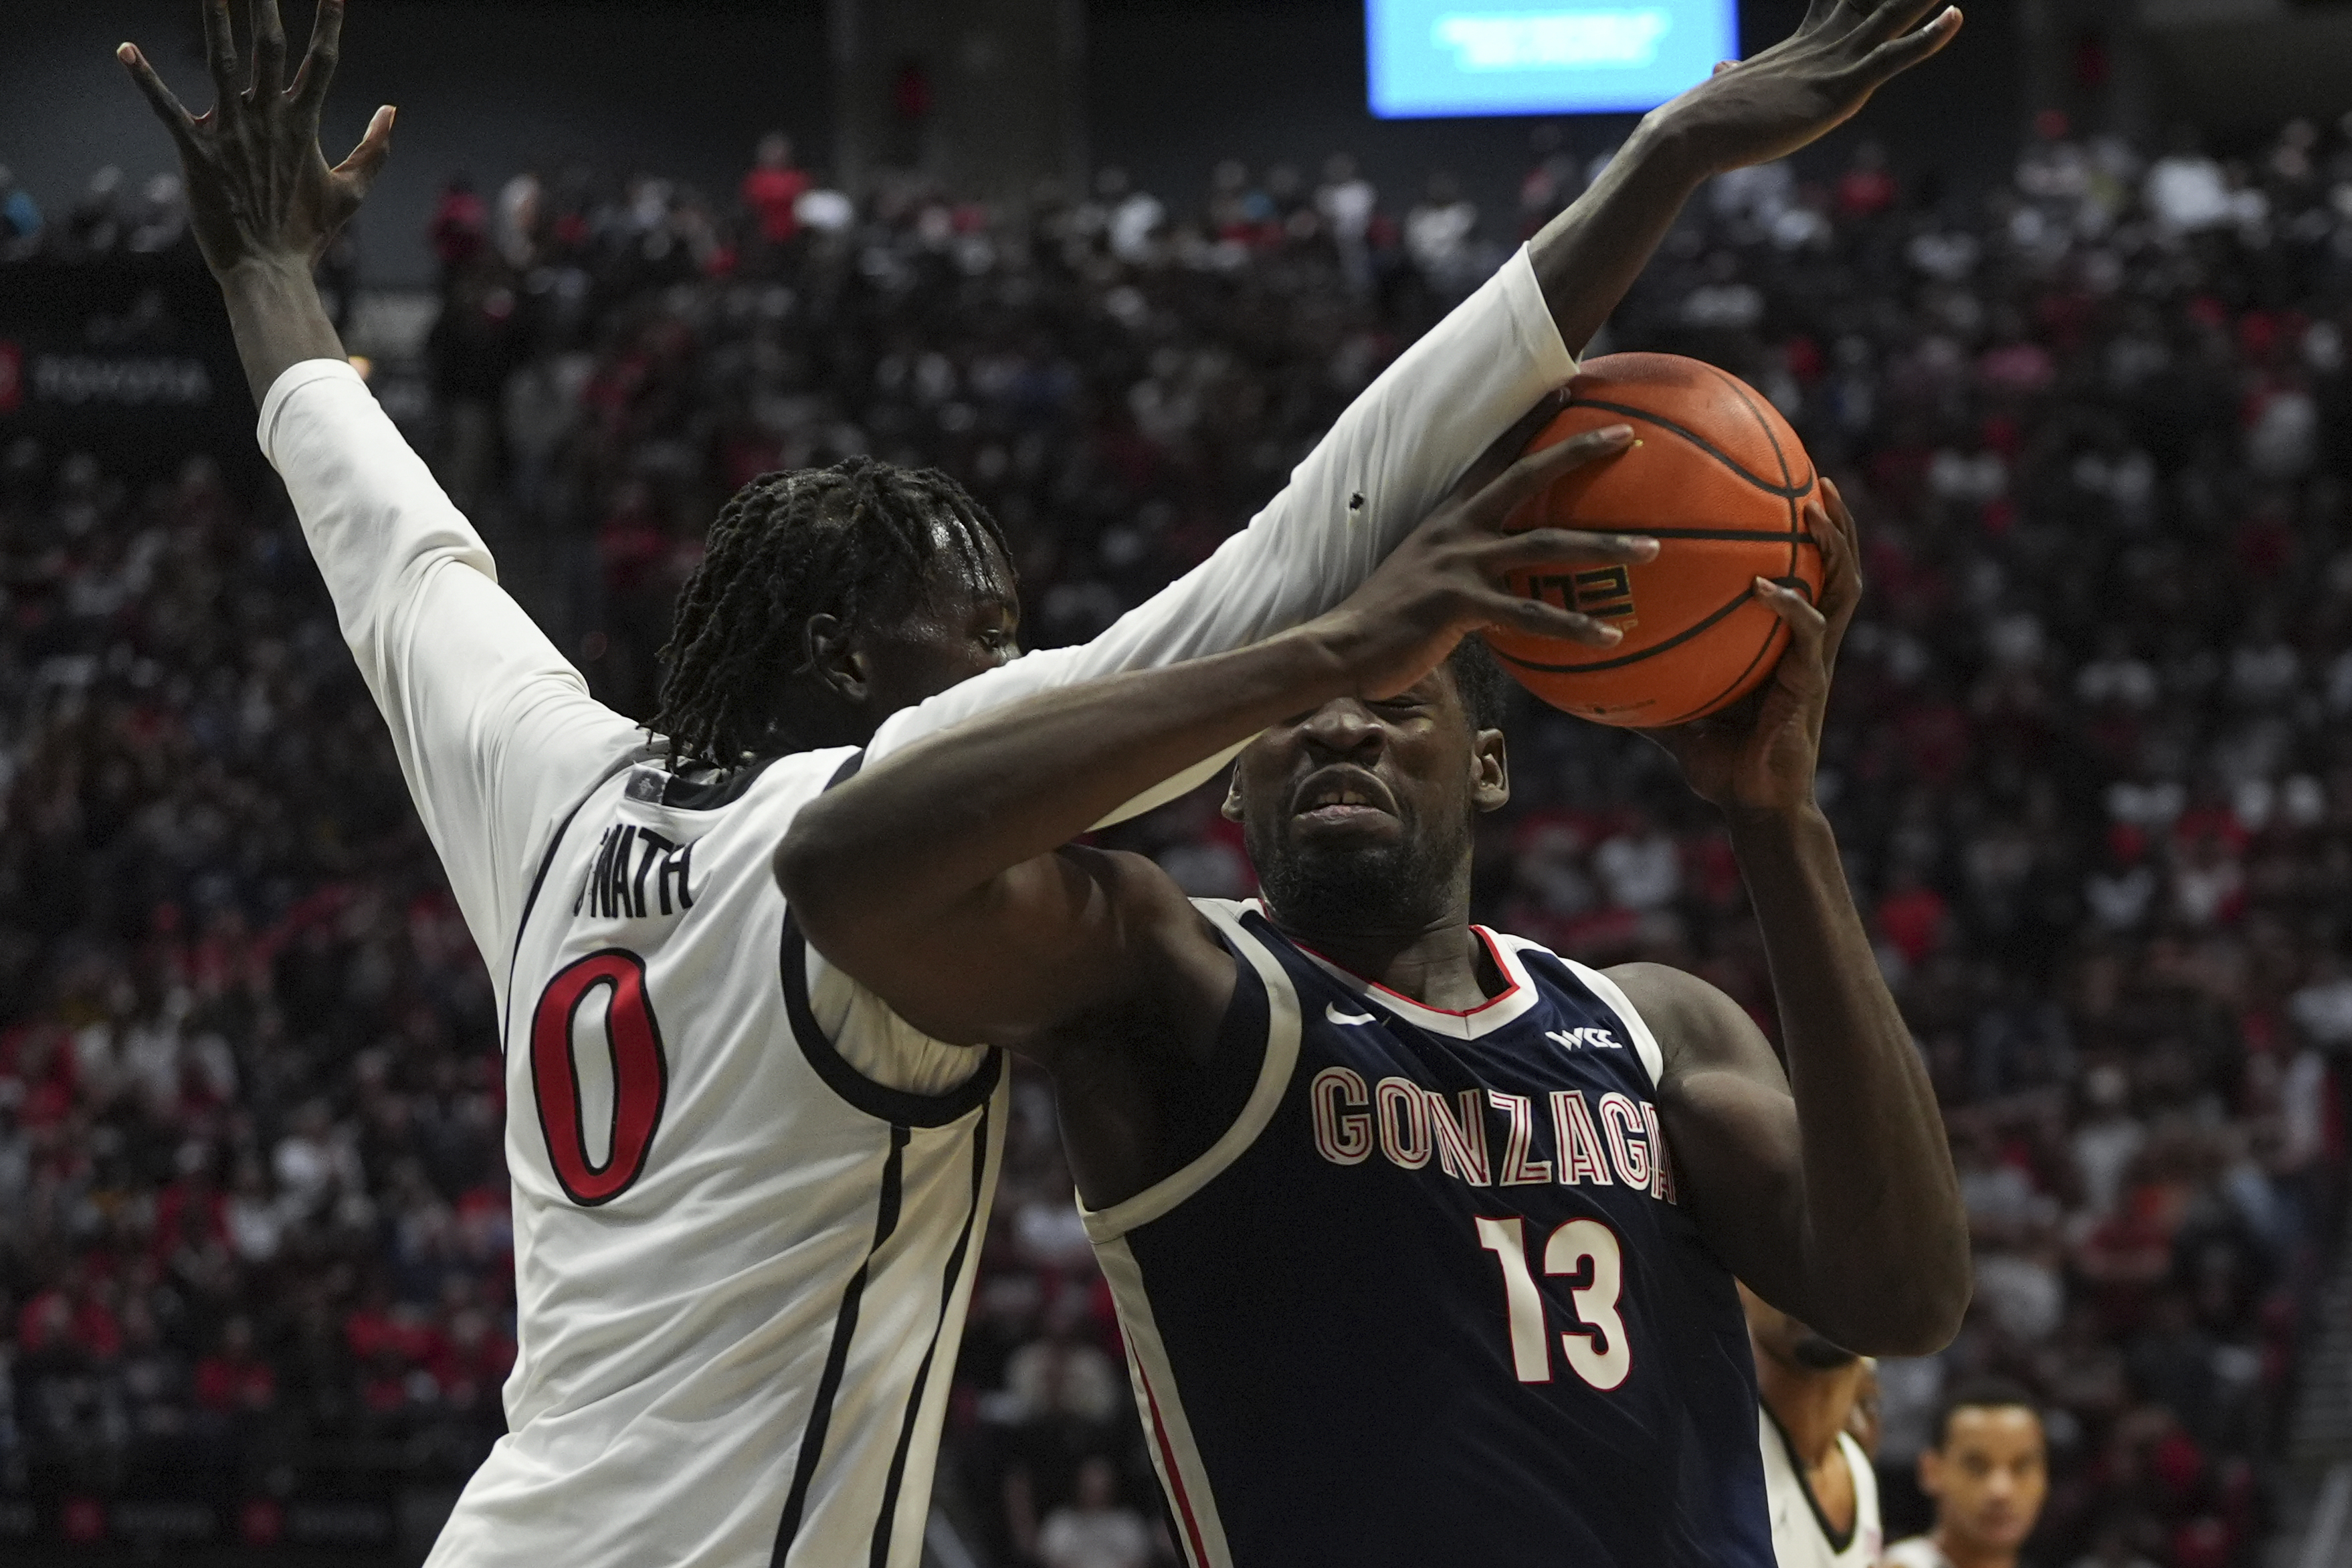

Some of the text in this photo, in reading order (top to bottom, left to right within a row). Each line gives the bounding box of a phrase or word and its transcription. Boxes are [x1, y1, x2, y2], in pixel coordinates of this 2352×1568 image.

[530, 947, 668, 1206] 0
[1544, 1027, 1624, 1052] WCC
[1310, 1065, 1677, 1205] GONZAGA
[1473, 1213, 1633, 1393] 13
